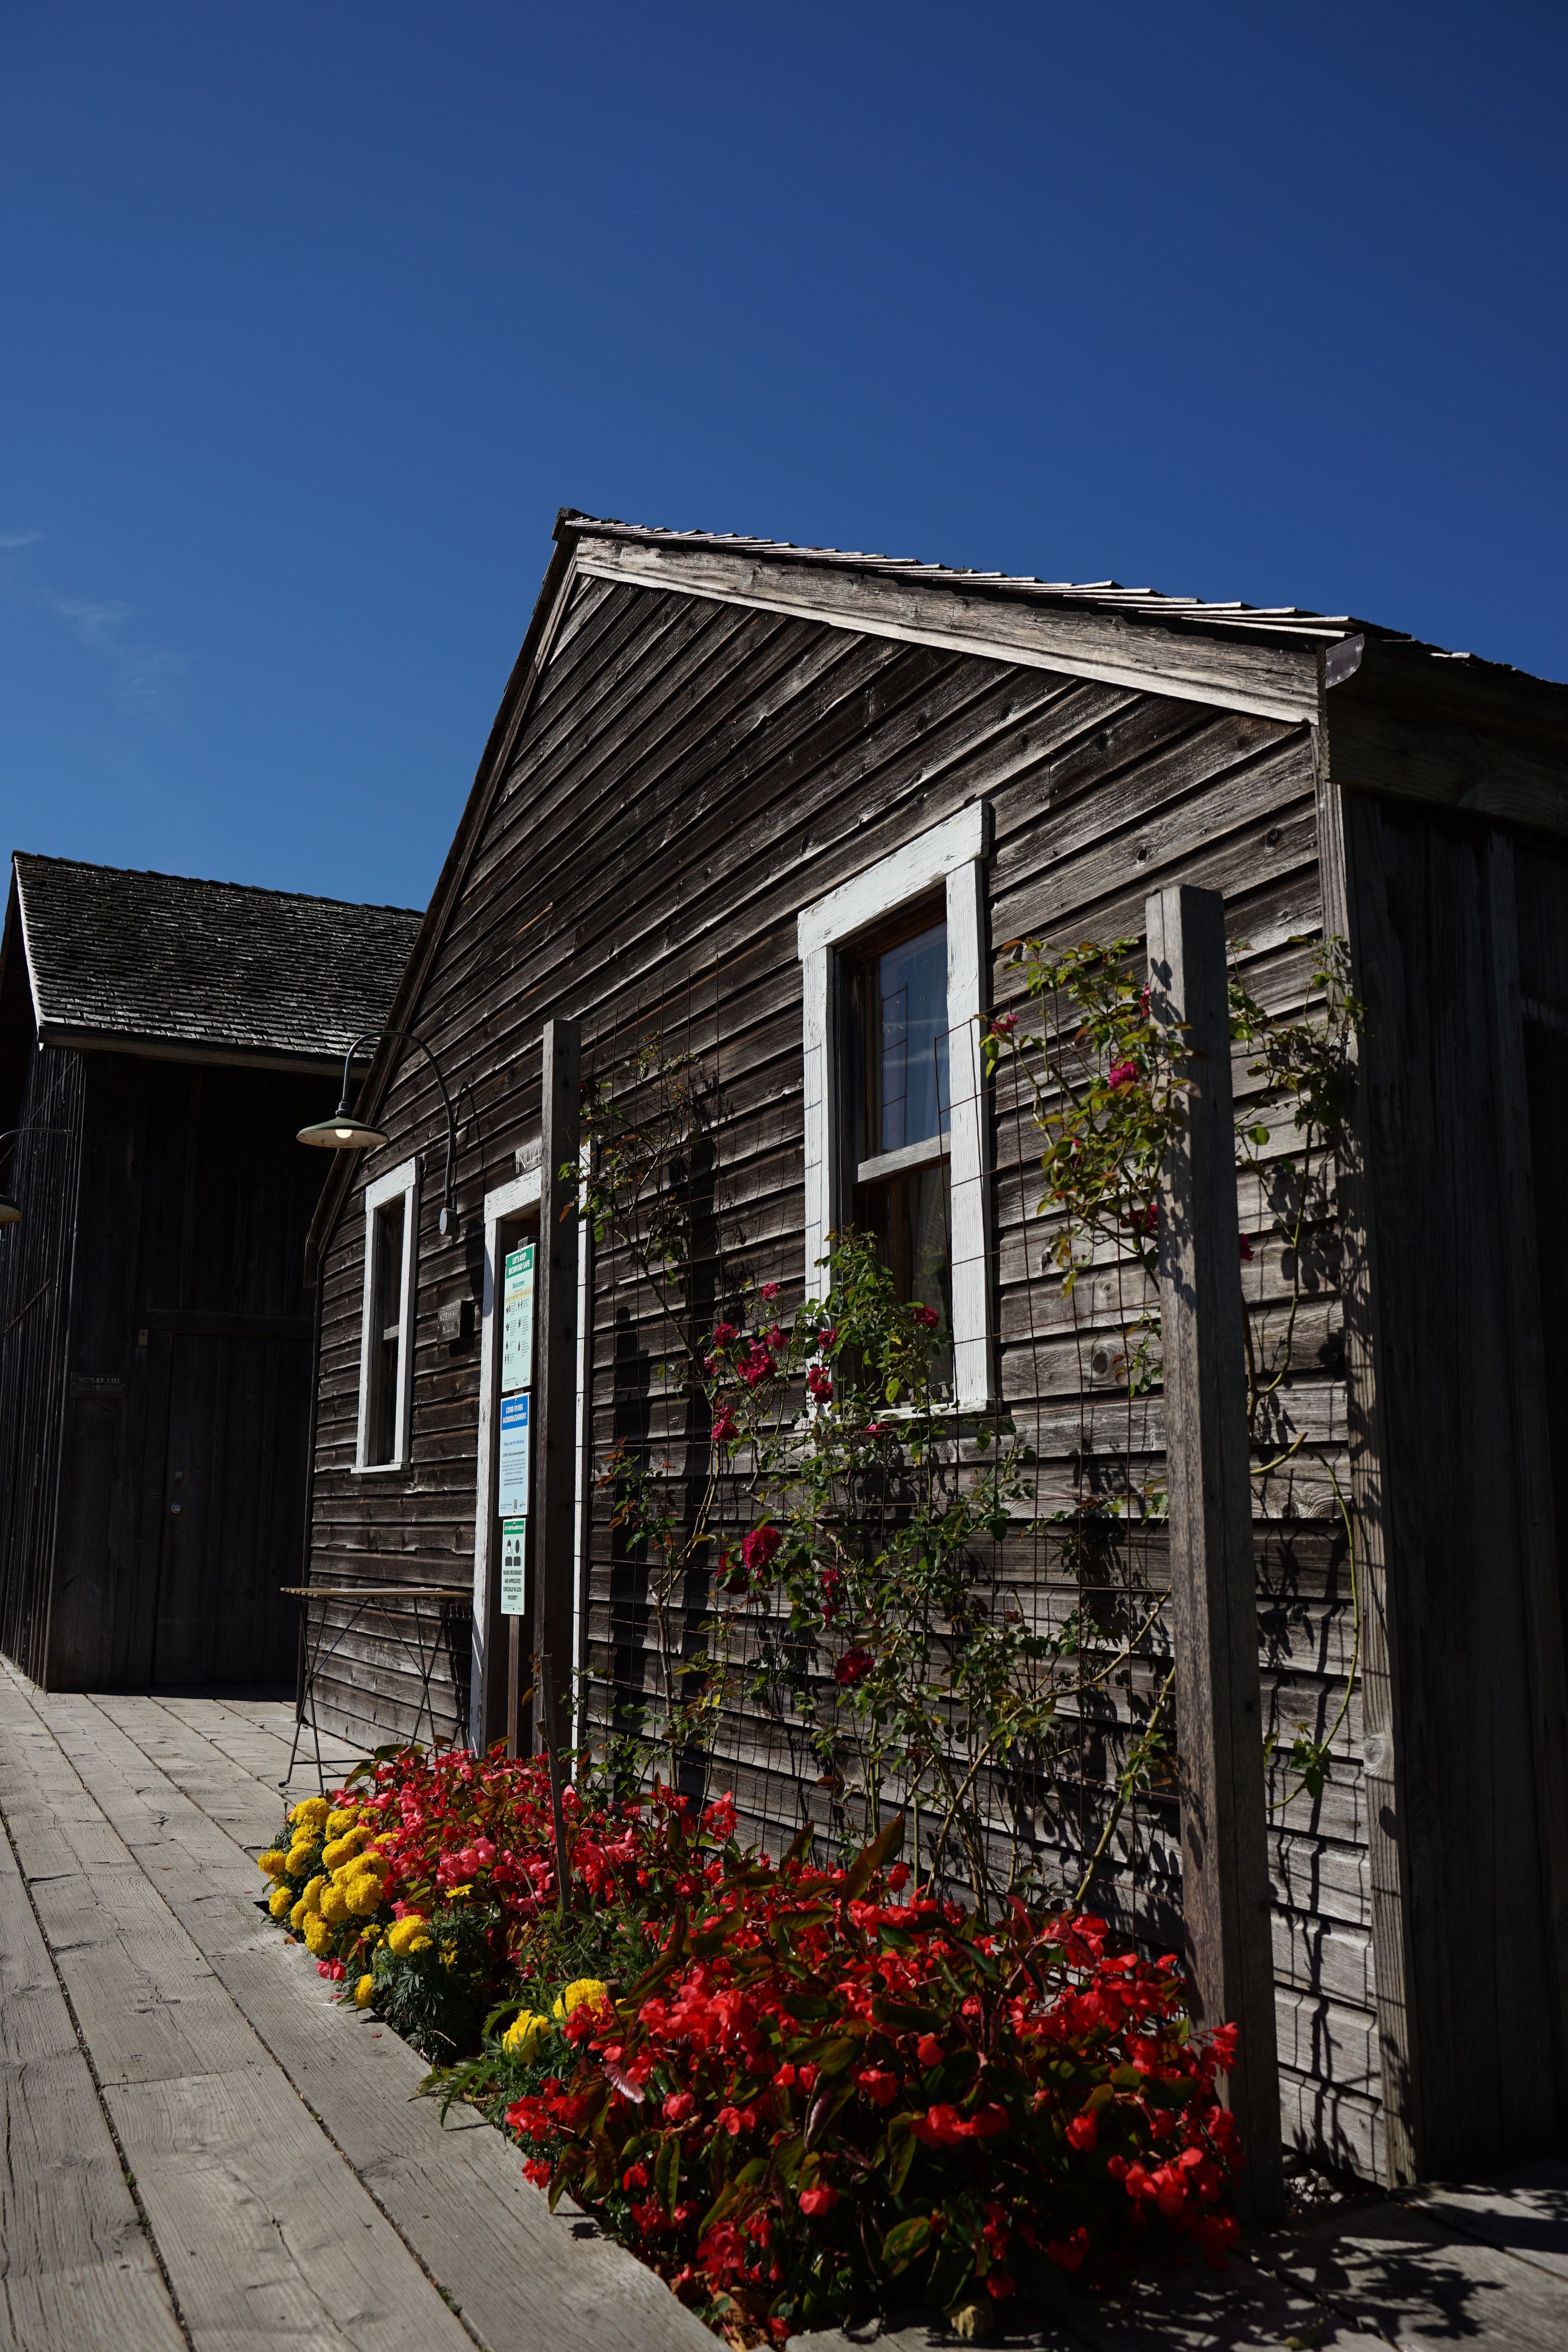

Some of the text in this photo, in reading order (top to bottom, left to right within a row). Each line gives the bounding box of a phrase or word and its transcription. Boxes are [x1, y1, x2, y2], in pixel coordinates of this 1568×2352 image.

[533, 1142, 541, 1163] 4
[512, 1280, 525, 1289] Welcome
[506, 1405, 517, 1414] COVID-19
